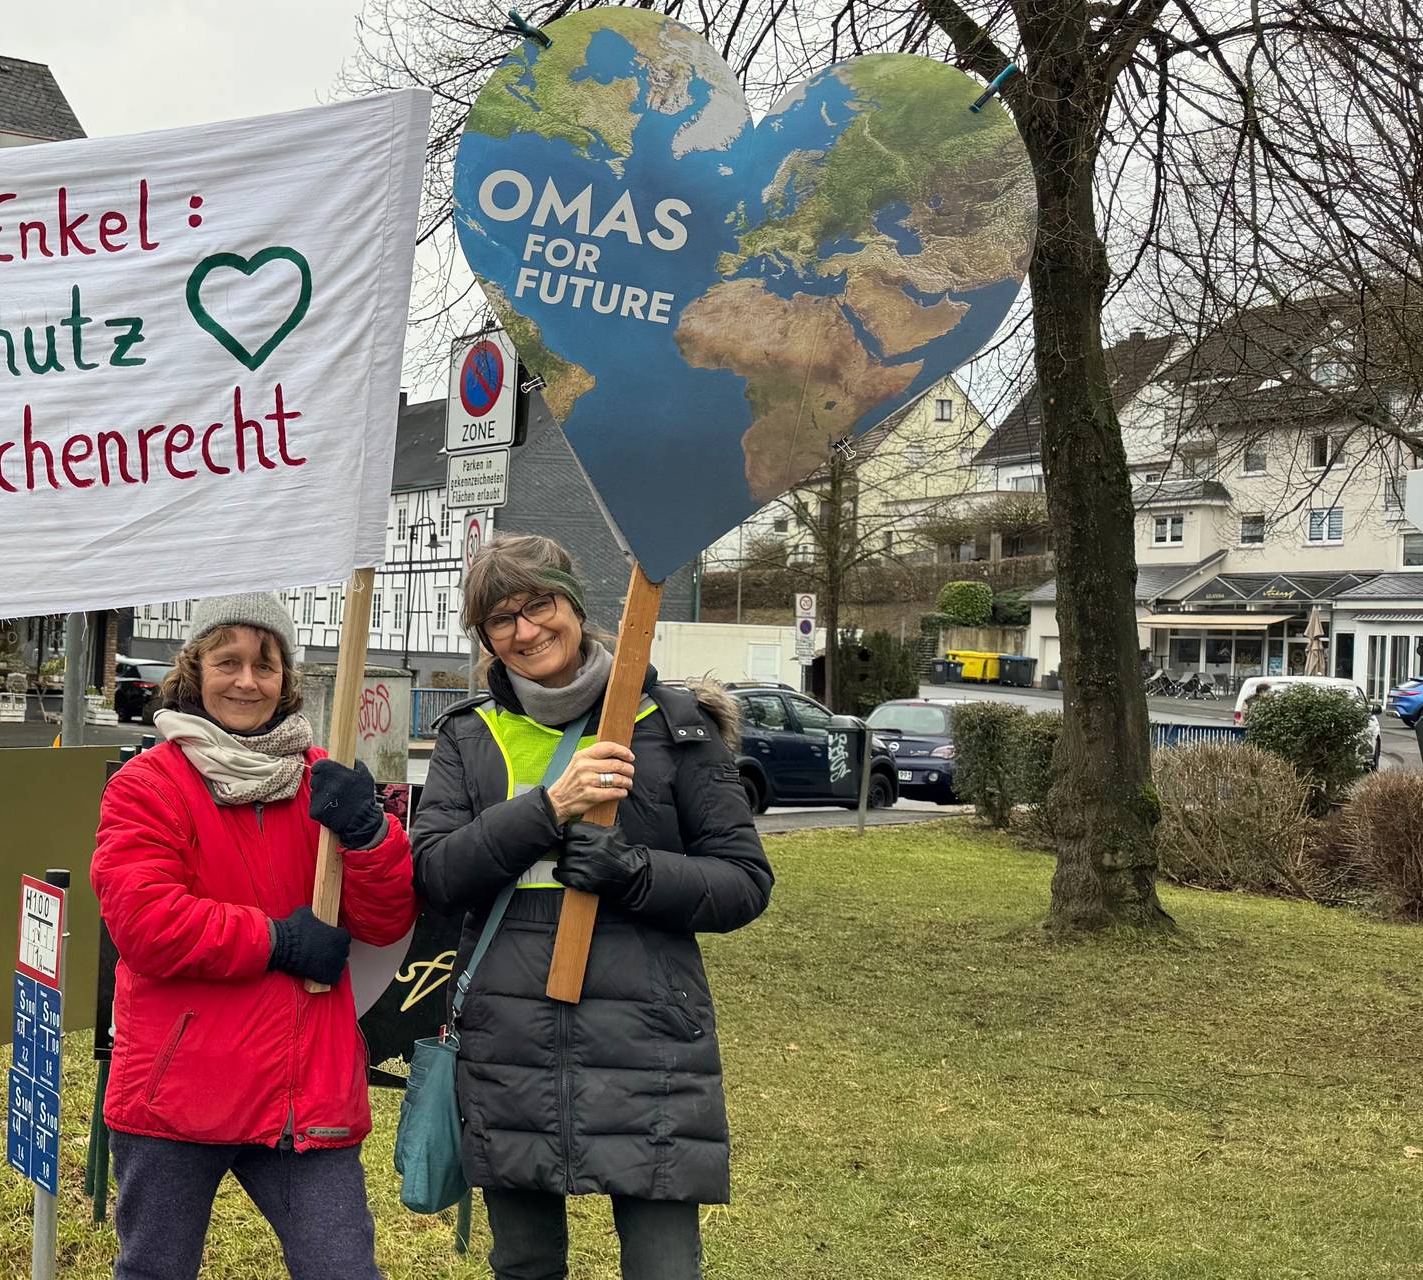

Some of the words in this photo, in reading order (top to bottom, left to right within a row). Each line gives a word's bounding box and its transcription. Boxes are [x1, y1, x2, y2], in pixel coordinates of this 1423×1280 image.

[478, 169, 692, 251] OMAS
[522, 233, 601, 273] FOR
[514, 267, 675, 324] FUTURE
[462, 420, 496, 442] ZONE
[463, 460, 484, 472] Parken
[486, 458, 493, 469] in
[452, 489, 475, 503] Flächen
[477, 487, 501, 501] erlaubt
[25, 889, 50, 917] H100
[42, 1001, 60, 1028] S100
[39, 1101, 58, 1131] S100
